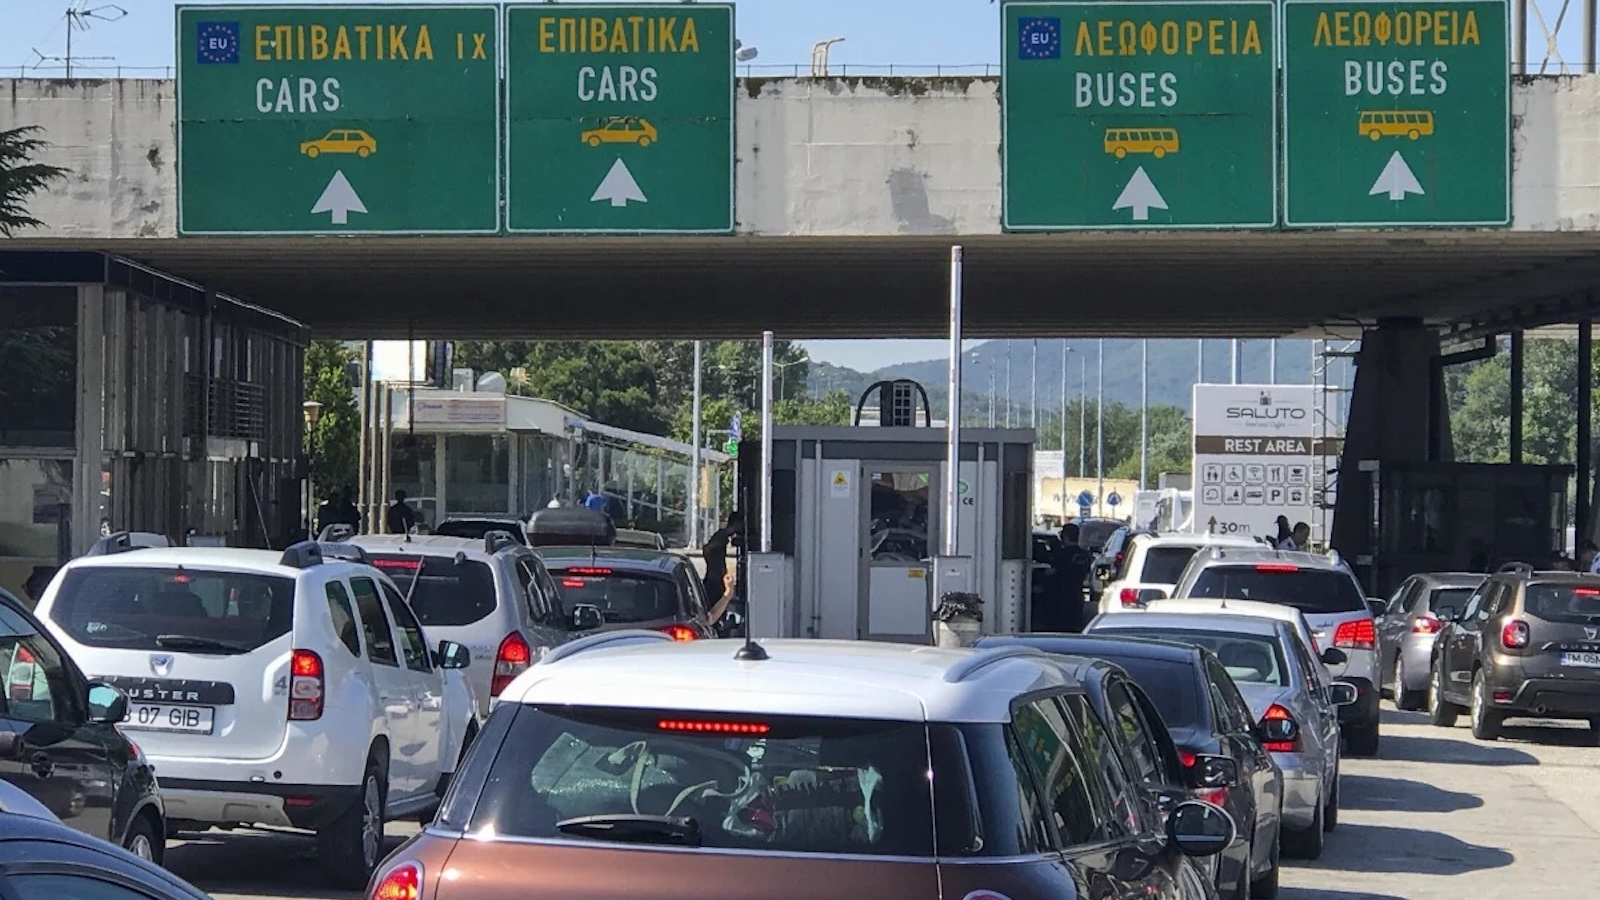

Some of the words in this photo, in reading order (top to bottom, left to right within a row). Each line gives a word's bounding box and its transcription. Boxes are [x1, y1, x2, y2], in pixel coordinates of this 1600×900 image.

[539, 16, 698, 53] ΕΠΙΒΑΤΙΚΑ
[1075, 20, 1262, 56] ΛΕΩΦΟΡΕΙΑ
[1313, 10, 1480, 47] ΛΕΩΦΟΡΕΙΑ
[209, 37, 228, 50] EU
[255, 25, 433, 60] ΕΠΙΒΑΤΙΚΑ
[1031, 33, 1049, 45] EU
[577, 66, 657, 101] CARS
[1345, 60, 1447, 96] BUSES
[256, 77, 340, 113] CARS
[1076, 72, 1177, 108] BUSES
[1226, 408, 1306, 419] SALUTO
[1224, 439, 1262, 452] REST
[1265, 440, 1306, 453] AREA
[1271, 489, 1280, 501] P
[1219, 522, 1250, 534] 30m
[274, 676, 288, 689] 4
[129, 687, 199, 701] USTER
[138, 707, 160, 724] 07
[169, 708, 200, 727] GIB
